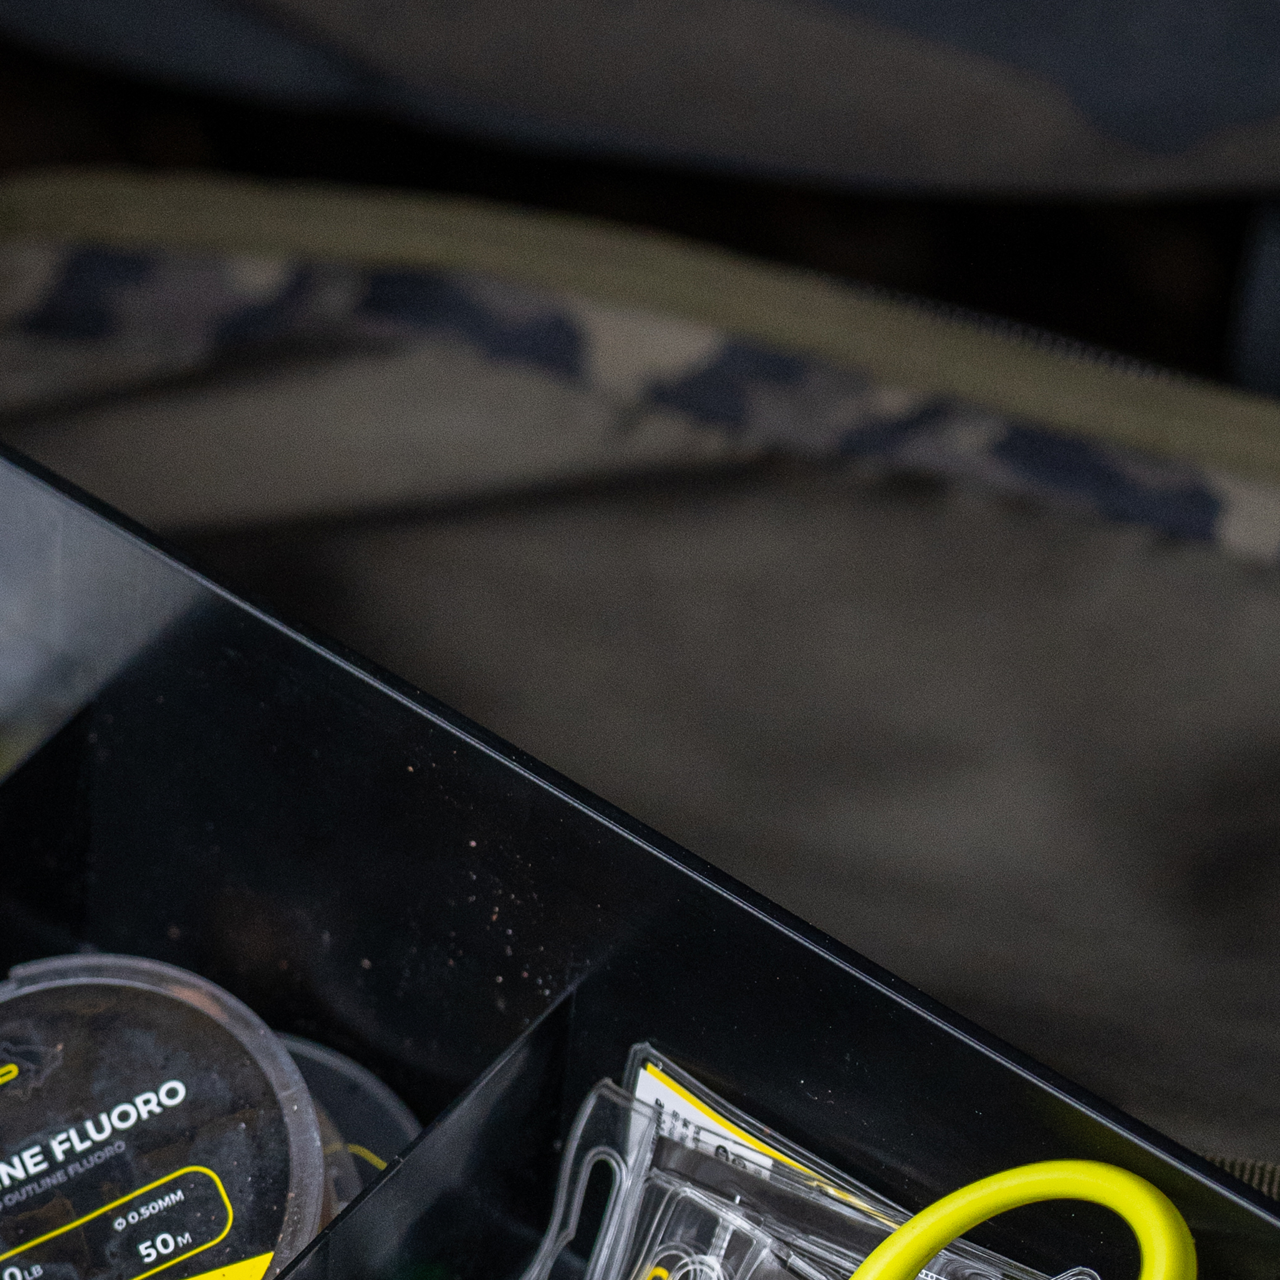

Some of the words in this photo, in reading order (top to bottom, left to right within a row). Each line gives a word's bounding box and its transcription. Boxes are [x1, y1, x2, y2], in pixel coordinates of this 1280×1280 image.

[50, 1080, 187, 1163] FLUORO
[3, 1169, 68, 1207] OUTLINE
[67, 1140, 127, 1179] FLUORO
[126, 1189, 185, 1225] 0.50MM
